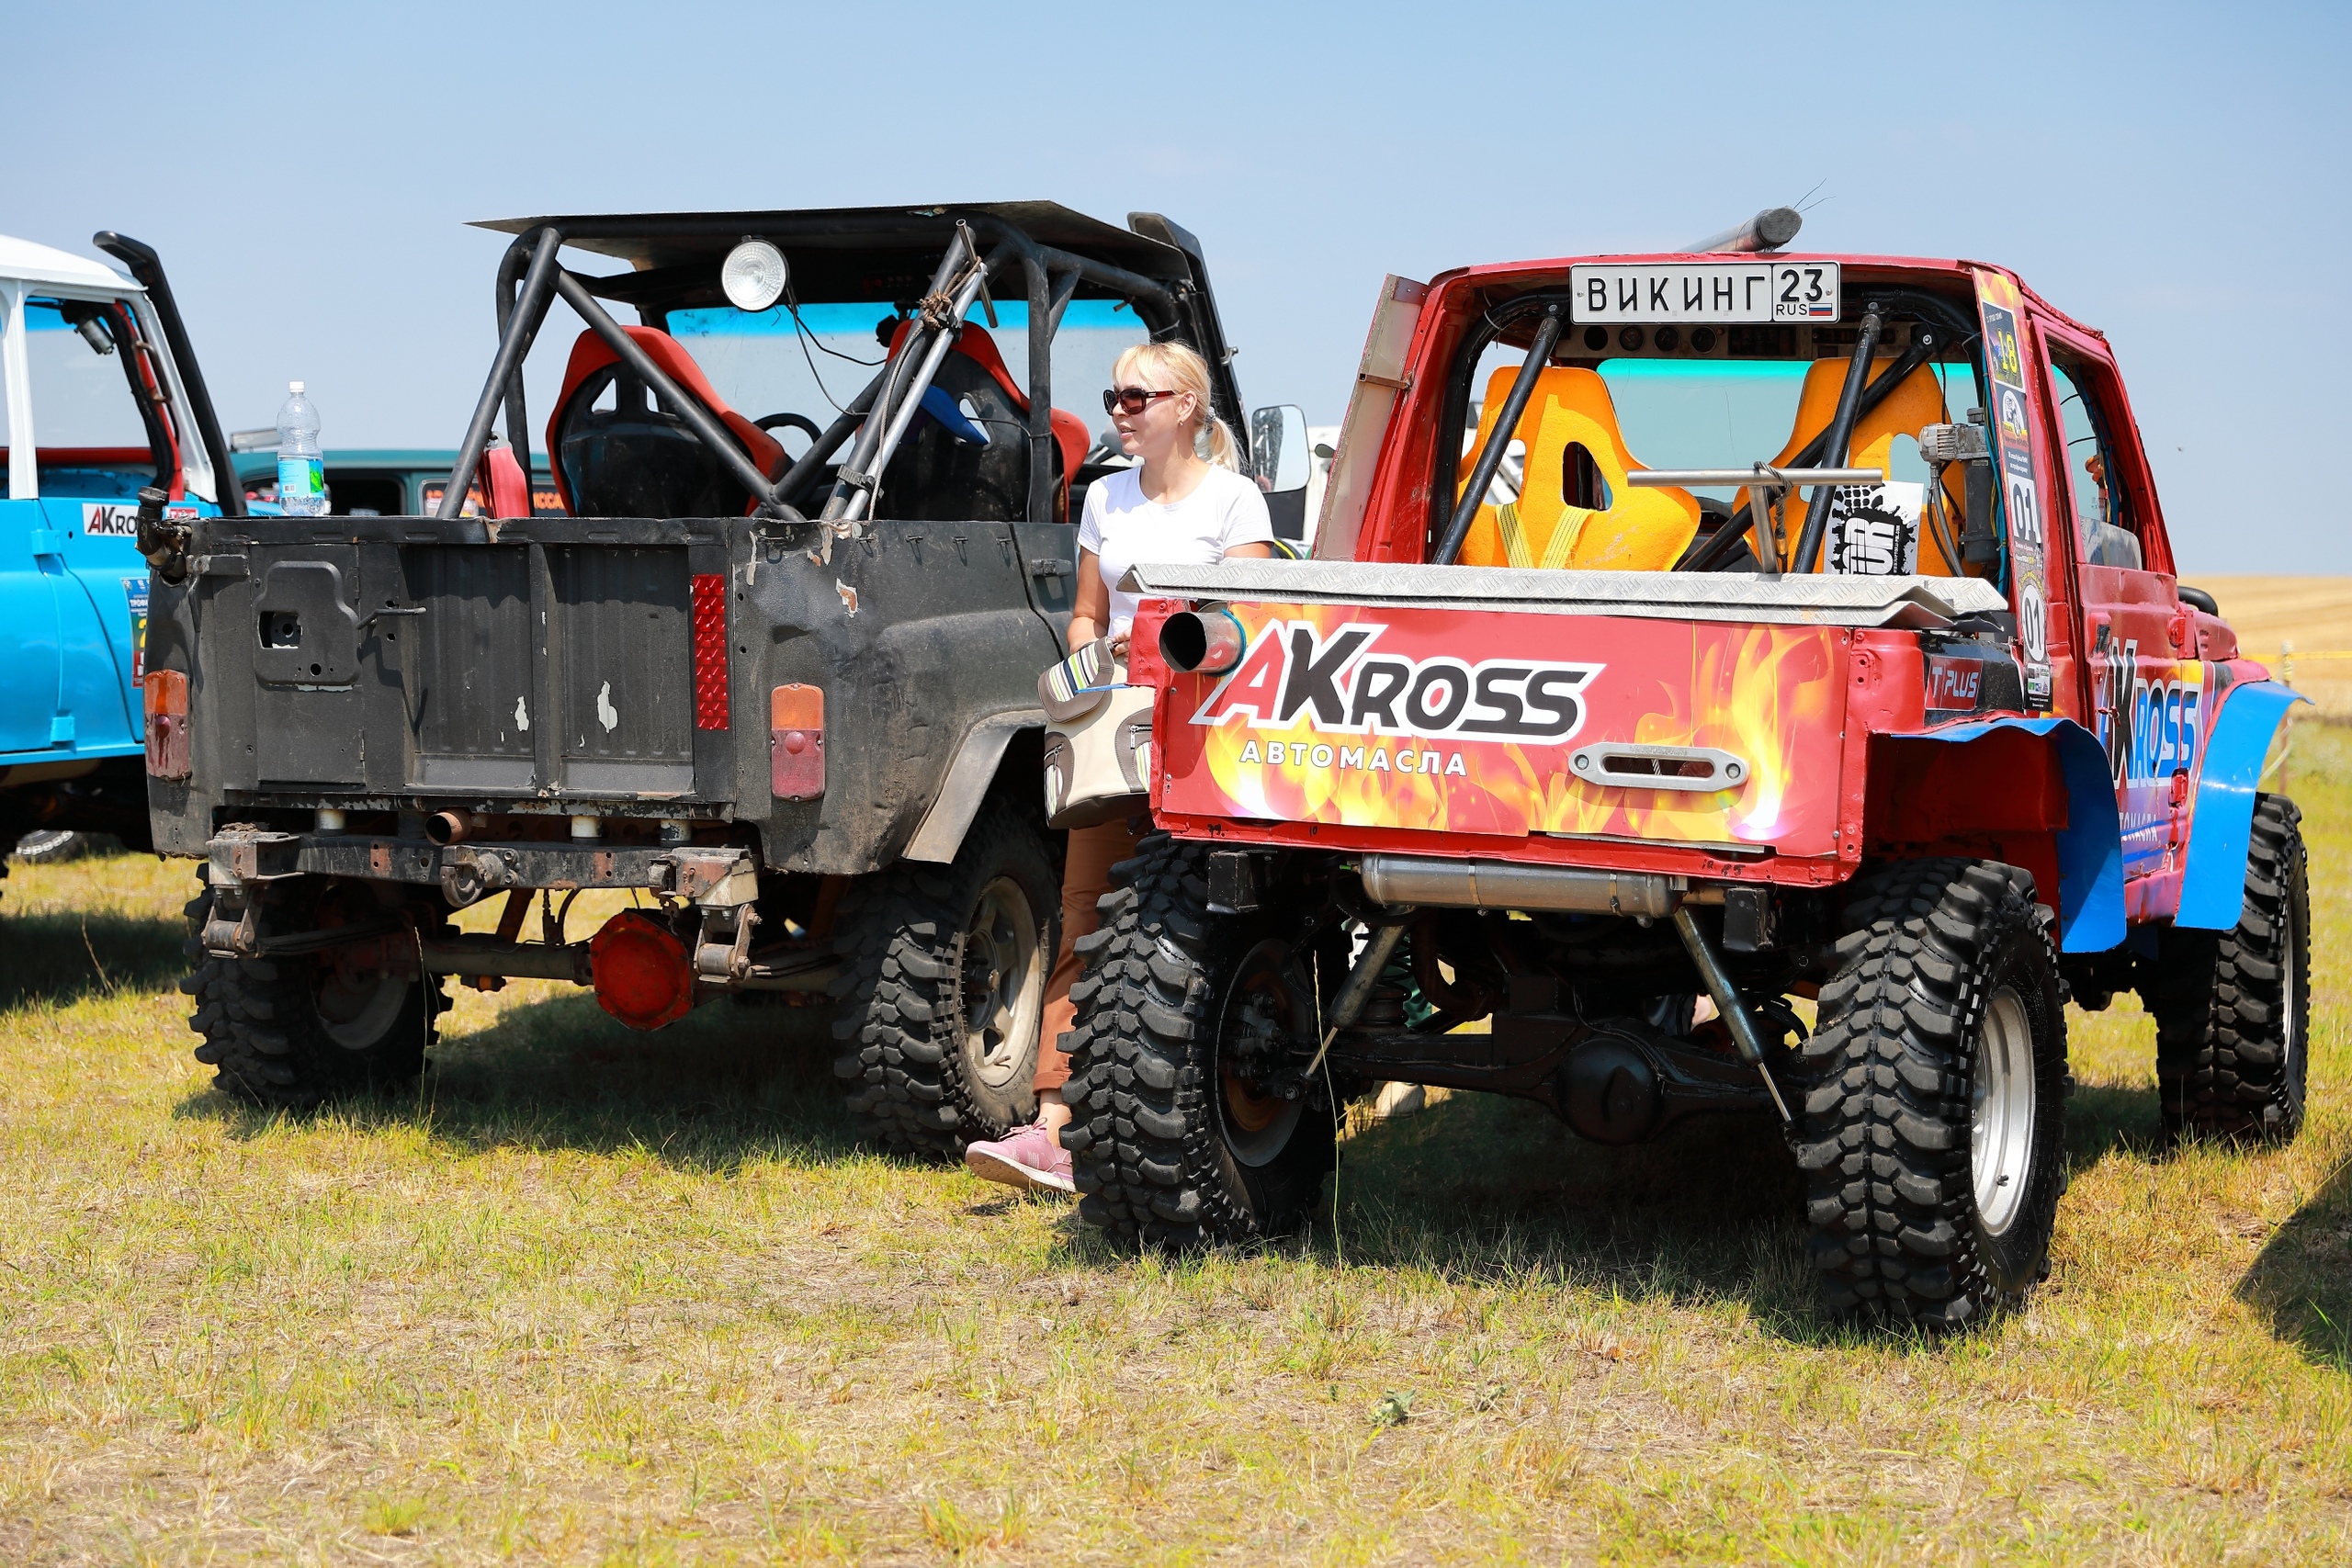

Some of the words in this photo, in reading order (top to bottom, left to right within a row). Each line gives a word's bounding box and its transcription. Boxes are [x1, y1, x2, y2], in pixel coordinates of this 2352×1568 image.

[1587, 276, 1766, 312] ВИКИНГ
[1780, 268, 1824, 303] 23
[1775, 304, 1808, 316] RUS
[1996, 328, 2018, 376] 18
[87, 506, 138, 535] AKRO
[2012, 483, 2037, 546] 01
[1841, 517, 1894, 574] OR
[2024, 597, 2042, 650] 01
[1943, 670, 1980, 698] PLUS
[1238, 739, 1468, 777] АВТОМАСЛА
[2119, 811, 2158, 842] ТОМАСЛА
